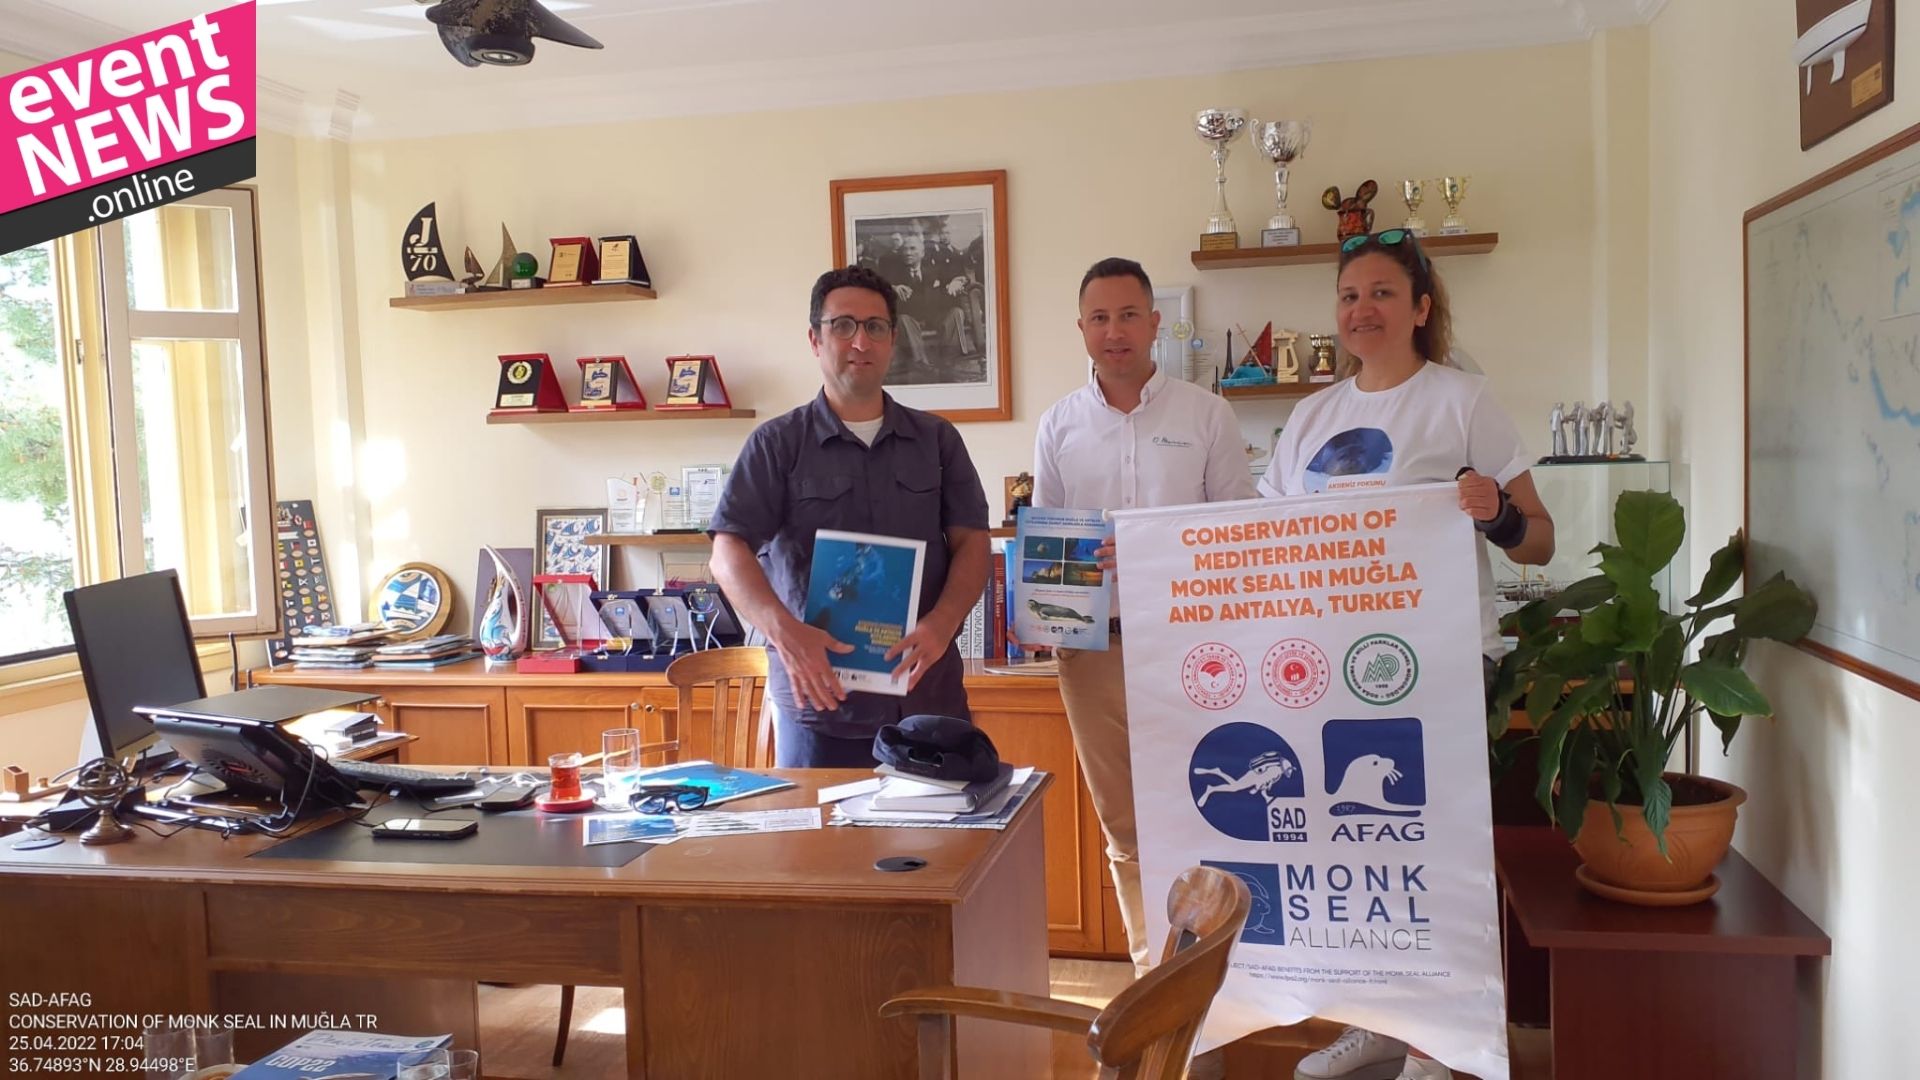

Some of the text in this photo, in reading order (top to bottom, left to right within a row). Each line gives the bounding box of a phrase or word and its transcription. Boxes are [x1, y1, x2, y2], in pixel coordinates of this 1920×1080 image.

[409, 255, 437, 272] 70
[1181, 508, 1398, 547] CONSERVATION OF
[1193, 537, 1386, 572] MEDITERRANEAN
[1171, 559, 1418, 599] MONK SEAL IN MUĞLA
[1169, 588, 1424, 624] AND ANTALYA, TURKEY
[1271, 807, 1306, 829] SAD
[1275, 833, 1305, 842] 1994
[1331, 822, 1425, 842] AFAG
[1287, 864, 1428, 892] MONK
[1289, 896, 1430, 923] SEAL
[1289, 926, 1433, 951] ALLIANCE
[1303, 967, 1319, 975] FROM
[1321, 968, 1332, 976] THE
[1362, 969, 1371, 977] OF
[1372, 969, 1384, 977] THE
[1422, 970, 1451, 978] ALLIANCE
